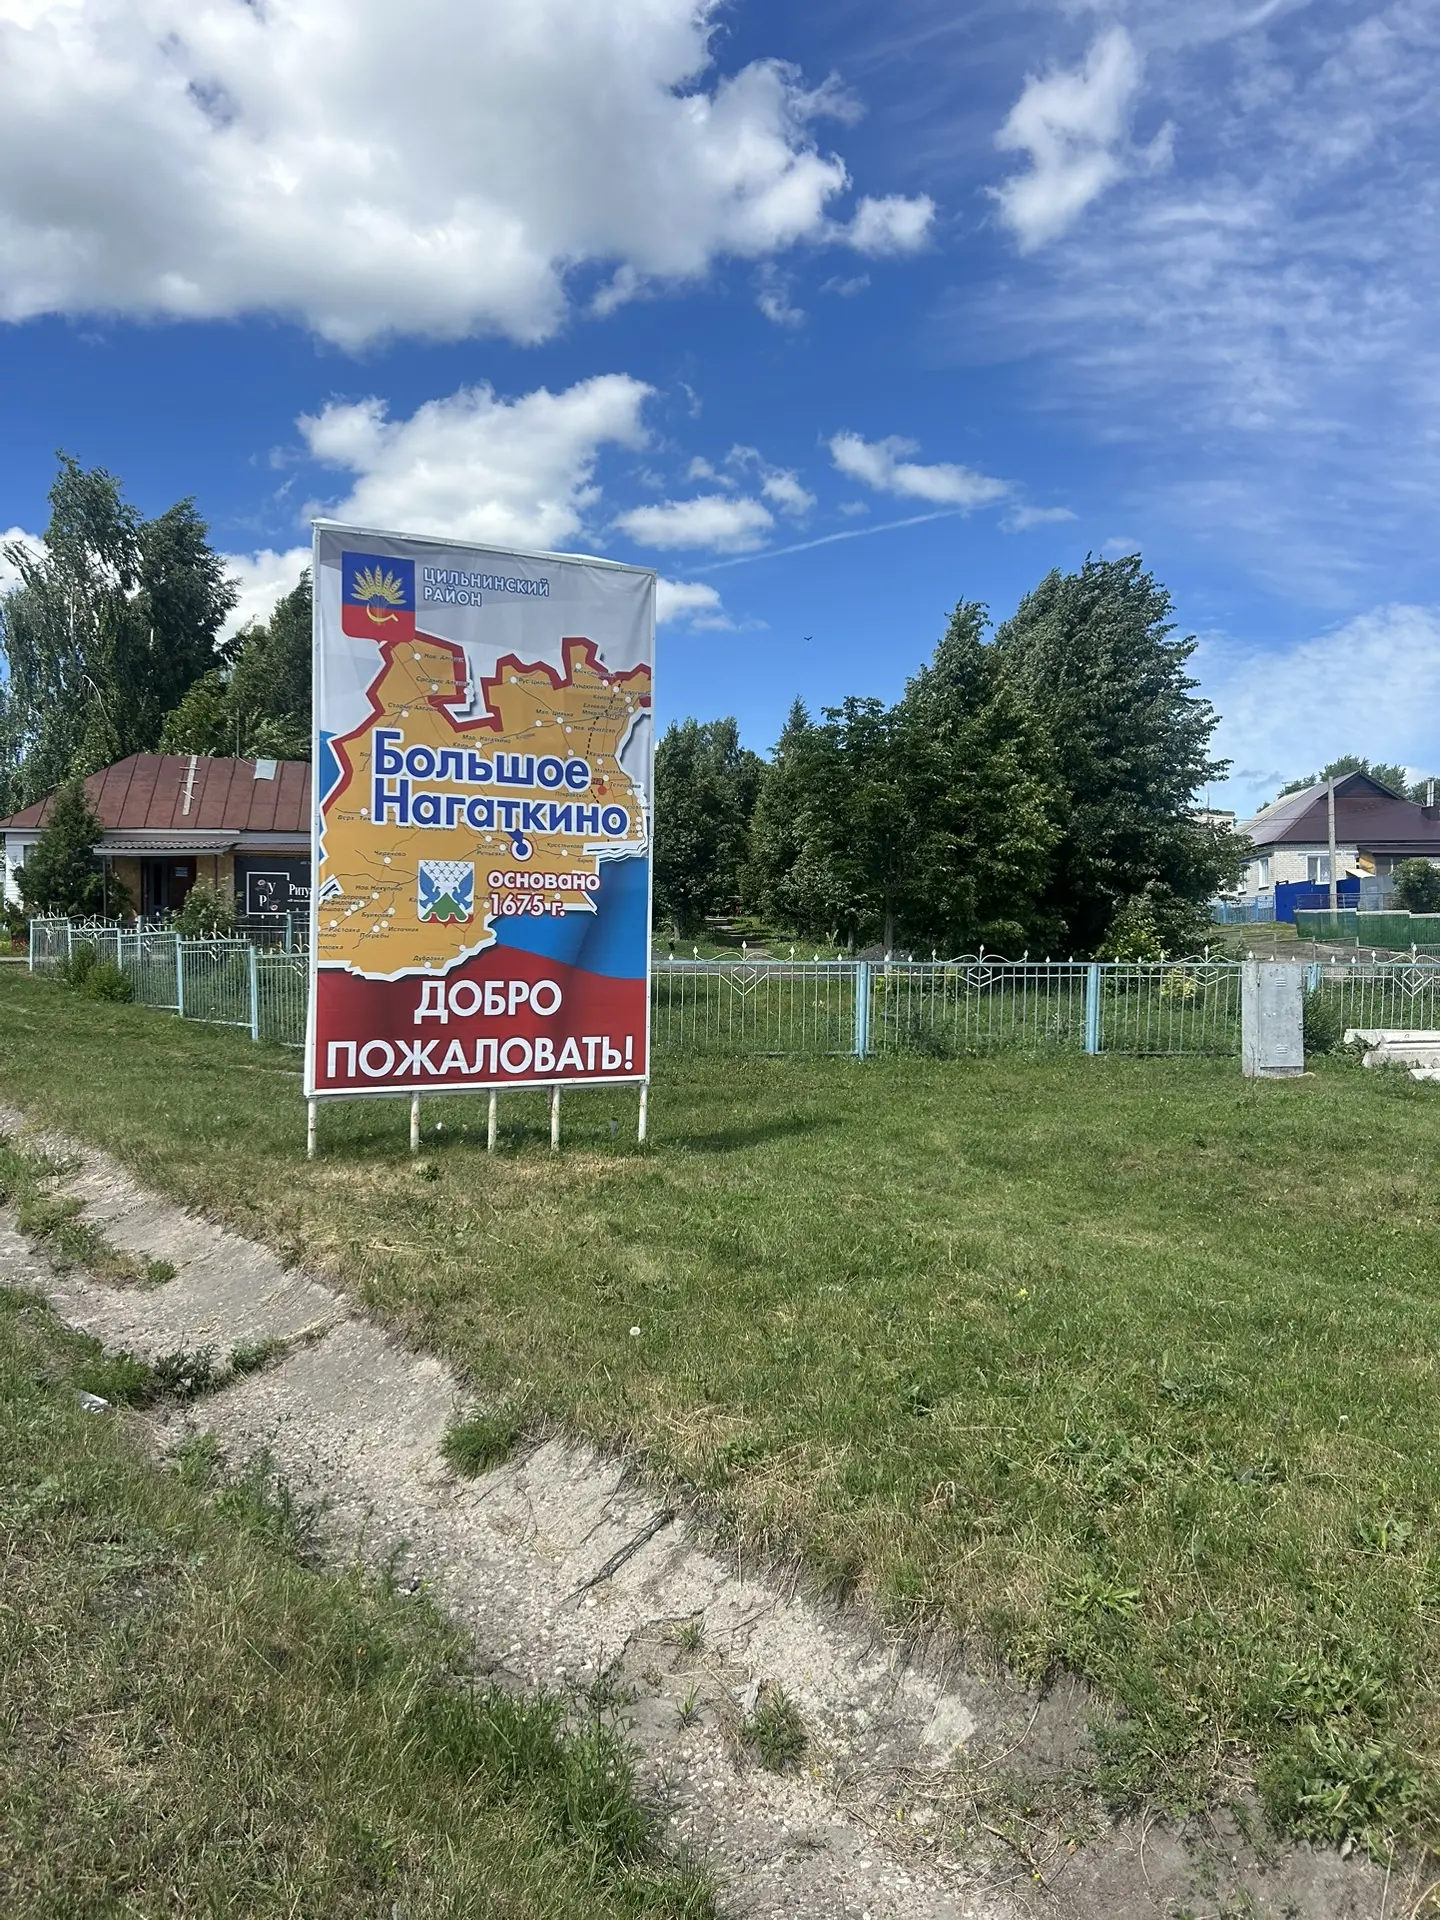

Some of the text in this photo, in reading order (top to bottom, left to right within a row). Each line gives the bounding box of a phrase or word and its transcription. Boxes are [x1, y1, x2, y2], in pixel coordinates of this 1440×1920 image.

[422, 566, 550, 597] ЦИЛЬНИНСКИЙ
[423, 586, 482, 607] РАЙОН
[374, 729, 590, 790] Большое
[373, 777, 629, 836] Нагаткино
[488, 870, 600, 891] основано
[490, 892, 567, 917] 1675 г.
[413, 979, 563, 1024] ДОБРО
[326, 1035, 634, 1078] ПОЖАЛОВАТЬ!
